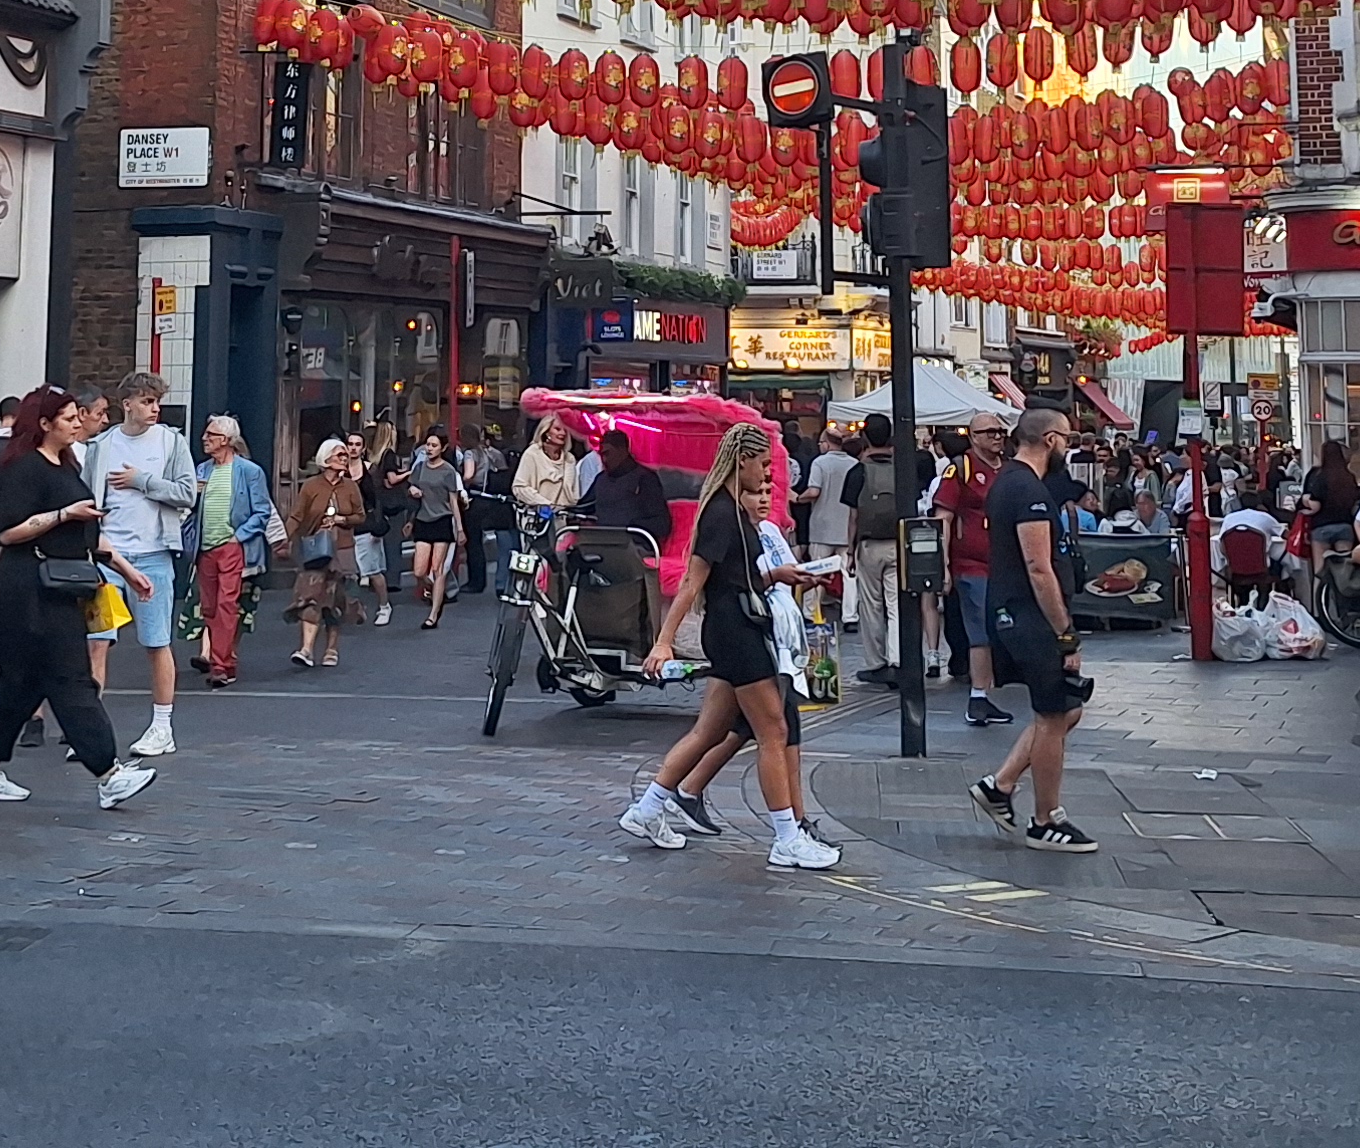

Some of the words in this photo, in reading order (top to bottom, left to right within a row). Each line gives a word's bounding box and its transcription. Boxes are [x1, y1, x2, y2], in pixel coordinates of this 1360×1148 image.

[126, 133, 169, 146] DANSEY
[126, 147, 160, 159] PLACE
[163, 146, 179, 159] W1
[788, 341, 832, 350] CORNER
[765, 351, 838, 362] RESTAURANT
[1255, 405, 1271, 416] 20
